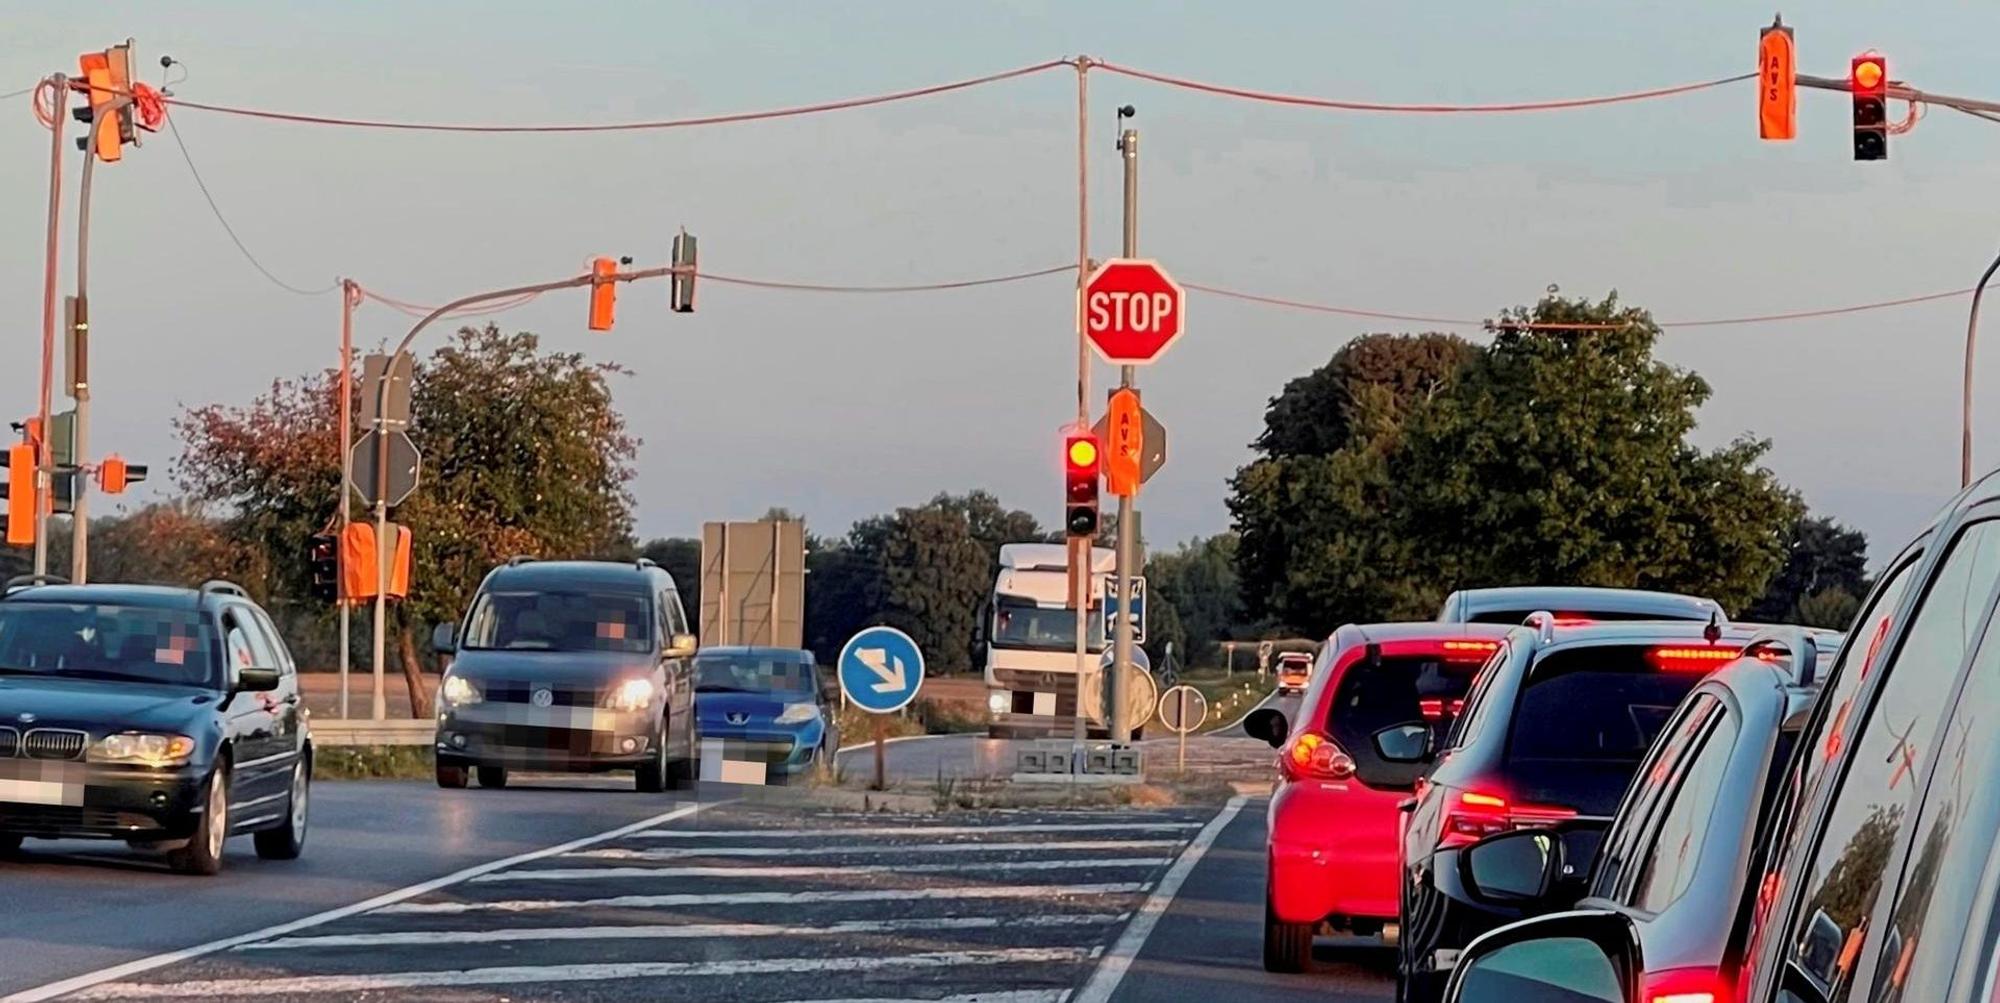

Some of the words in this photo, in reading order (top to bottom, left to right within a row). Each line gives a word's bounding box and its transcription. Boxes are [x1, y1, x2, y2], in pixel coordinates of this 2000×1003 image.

[1769, 56, 1780, 101] AVS
[1089, 291, 1172, 333] STOP
[1120, 412, 1129, 457] AVS
